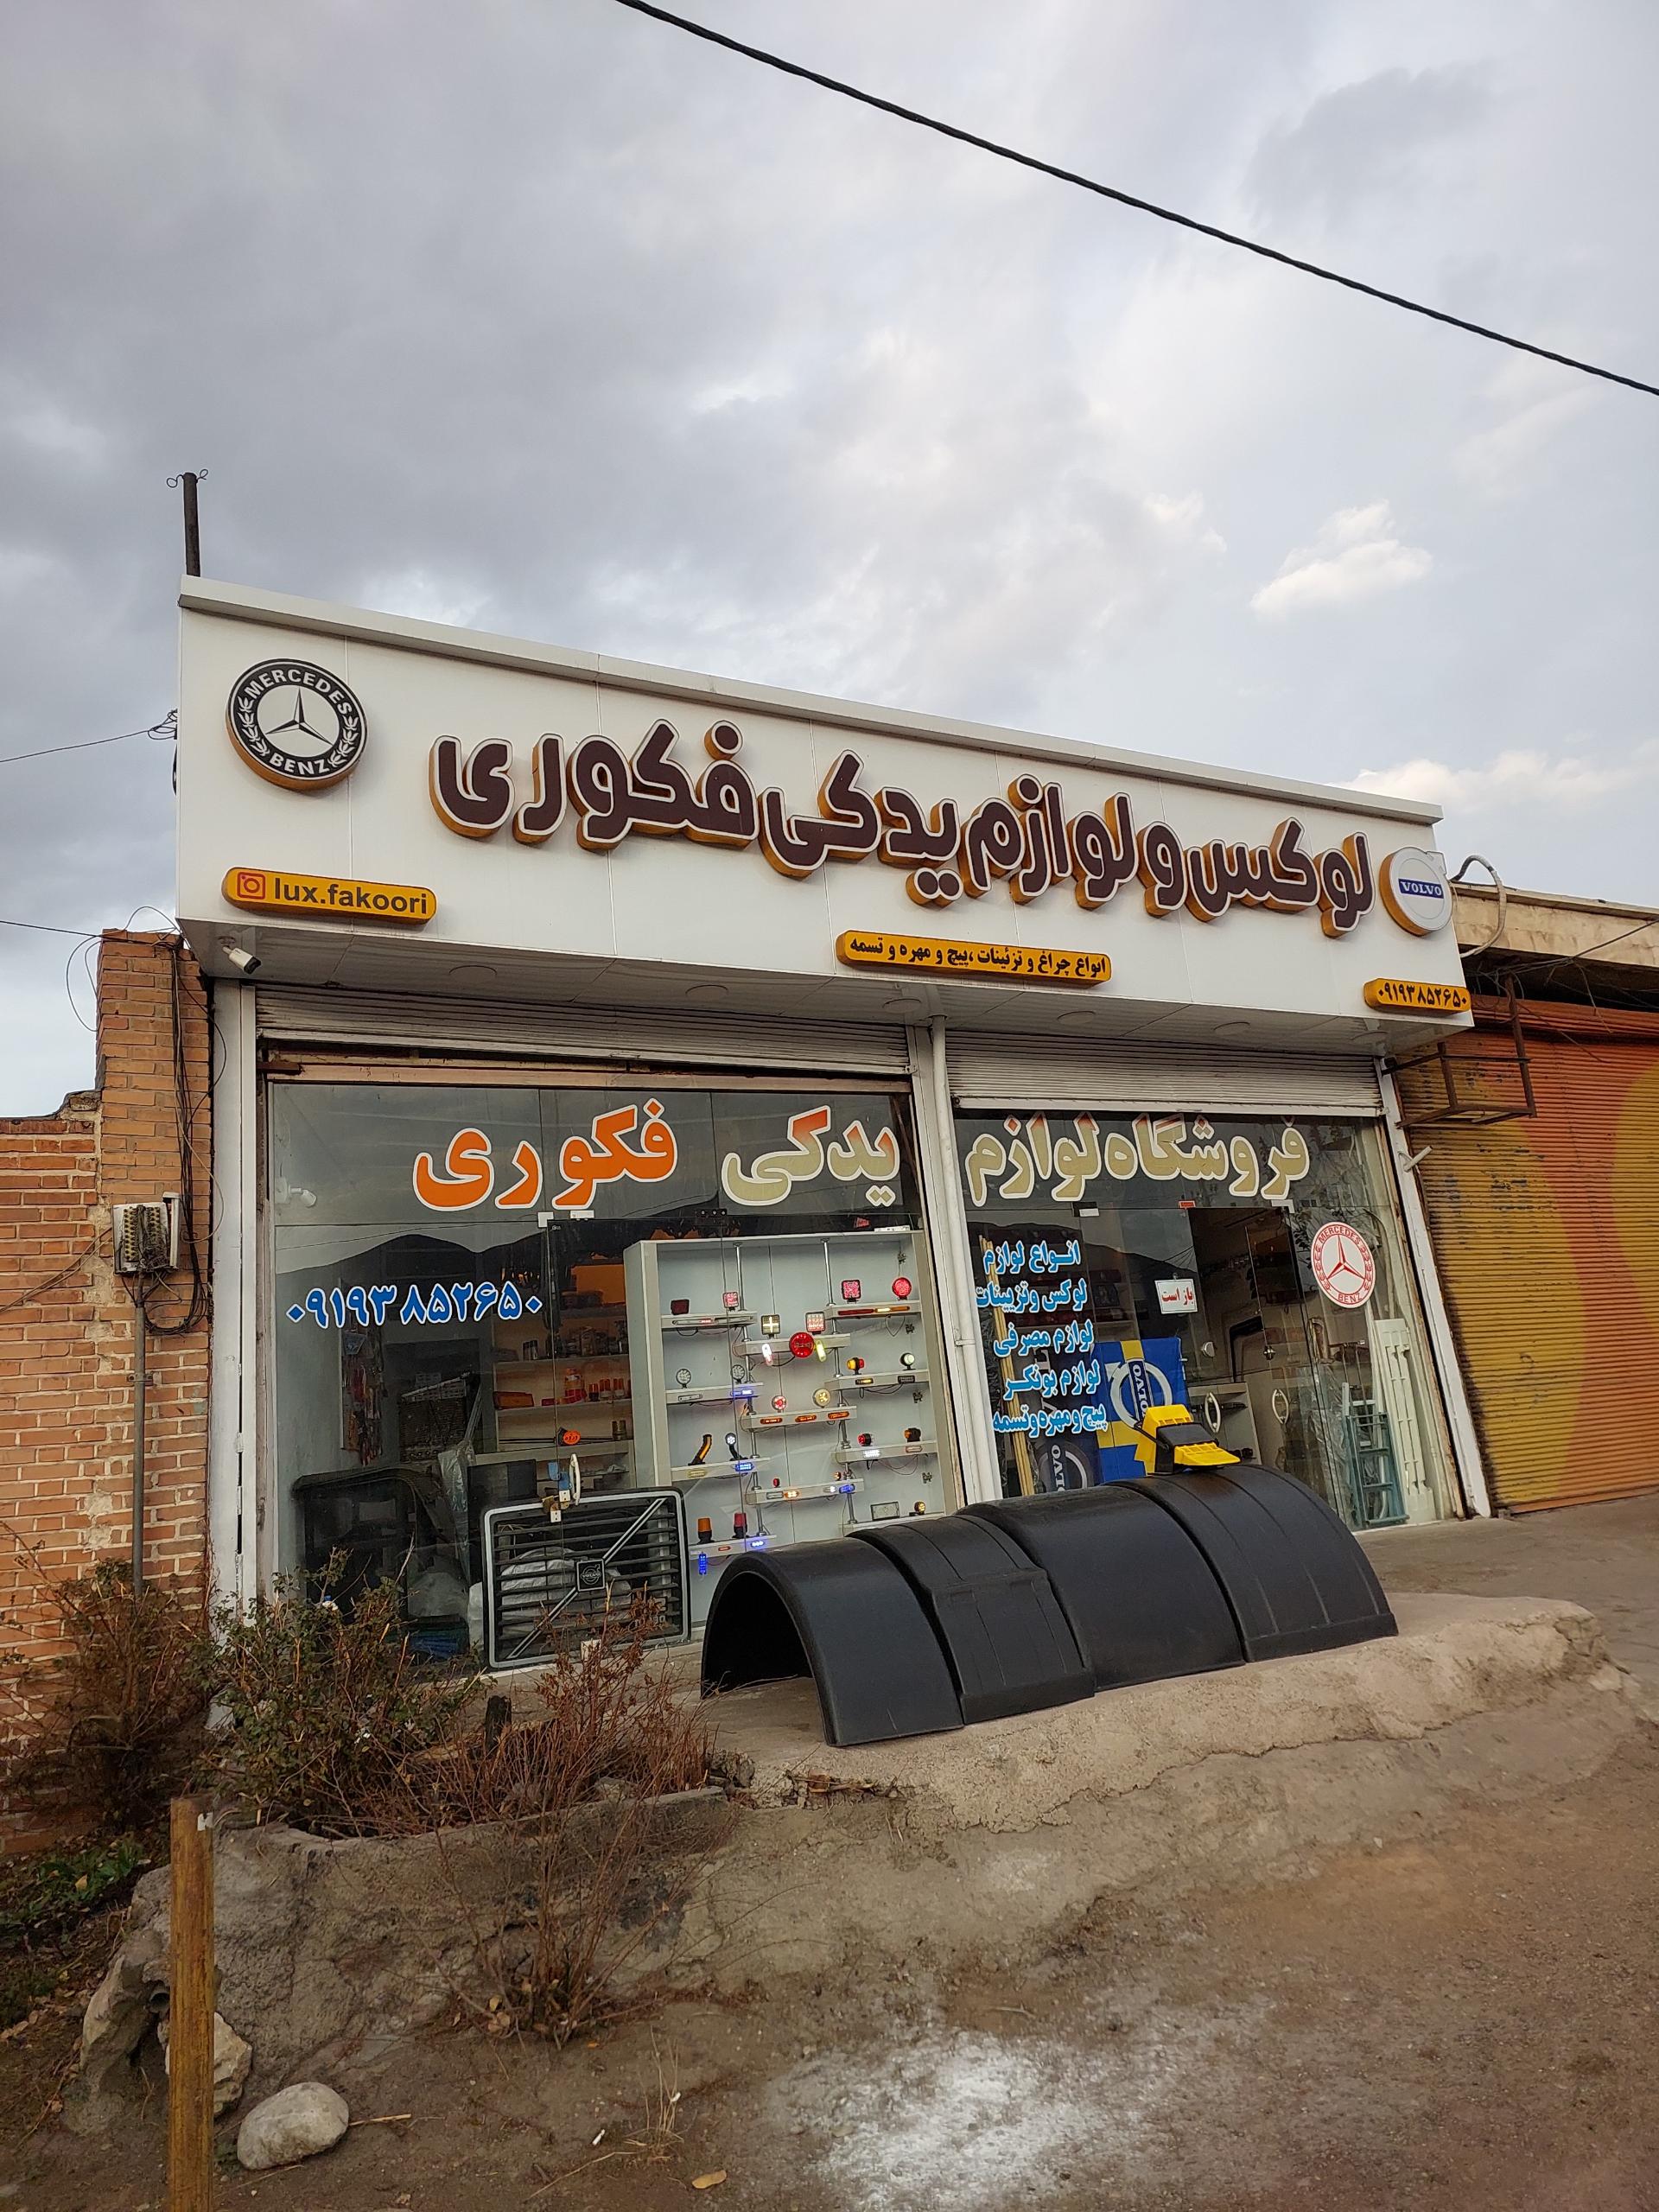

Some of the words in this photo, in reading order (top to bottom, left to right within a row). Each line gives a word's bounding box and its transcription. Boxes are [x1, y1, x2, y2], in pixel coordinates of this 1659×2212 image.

[244, 669, 353, 715] MERCEDES
[269, 752, 330, 775] BENZ
[431, 719, 759, 845] فکوری
[759, 748, 961, 907] یدکی
[275, 878, 427, 914] lux.fakoori
[1400, 880, 1443, 897] VOLVO
[850, 938, 883, 954] تسمه
[888, 944, 895, 960] و
[899, 943, 931, 963] مهره
[936, 949, 943, 964] و
[1038, 950, 1071, 976] چراغ
[1027, 957, 1034, 974] و
[1076, 957, 1106, 977] انواع
[412, 1097, 678, 1210] فکوری
[721, 1104, 900, 1207] یدکی
[964, 1111, 1102, 1207] لوازم
[1104, 1113, 1310, 1200] فروشگاه
[1319, 1226, 1362, 1245] MERCEDES
[983, 1240, 1026, 1274] لوازم
[1041, 1278, 1087, 1312] لوکس
[1161, 1287, 1180, 1302] است
[1183, 1287, 1194, 1306] باز
[1338, 1293, 1363, 1303] BENZ
[993, 1322, 1051, 1357] مصرفی
[1053, 1319, 1094, 1354] لوازم
[1059, 1359, 1102, 1396] لوازم
[1133, 1364, 1149, 1417] OLVO
